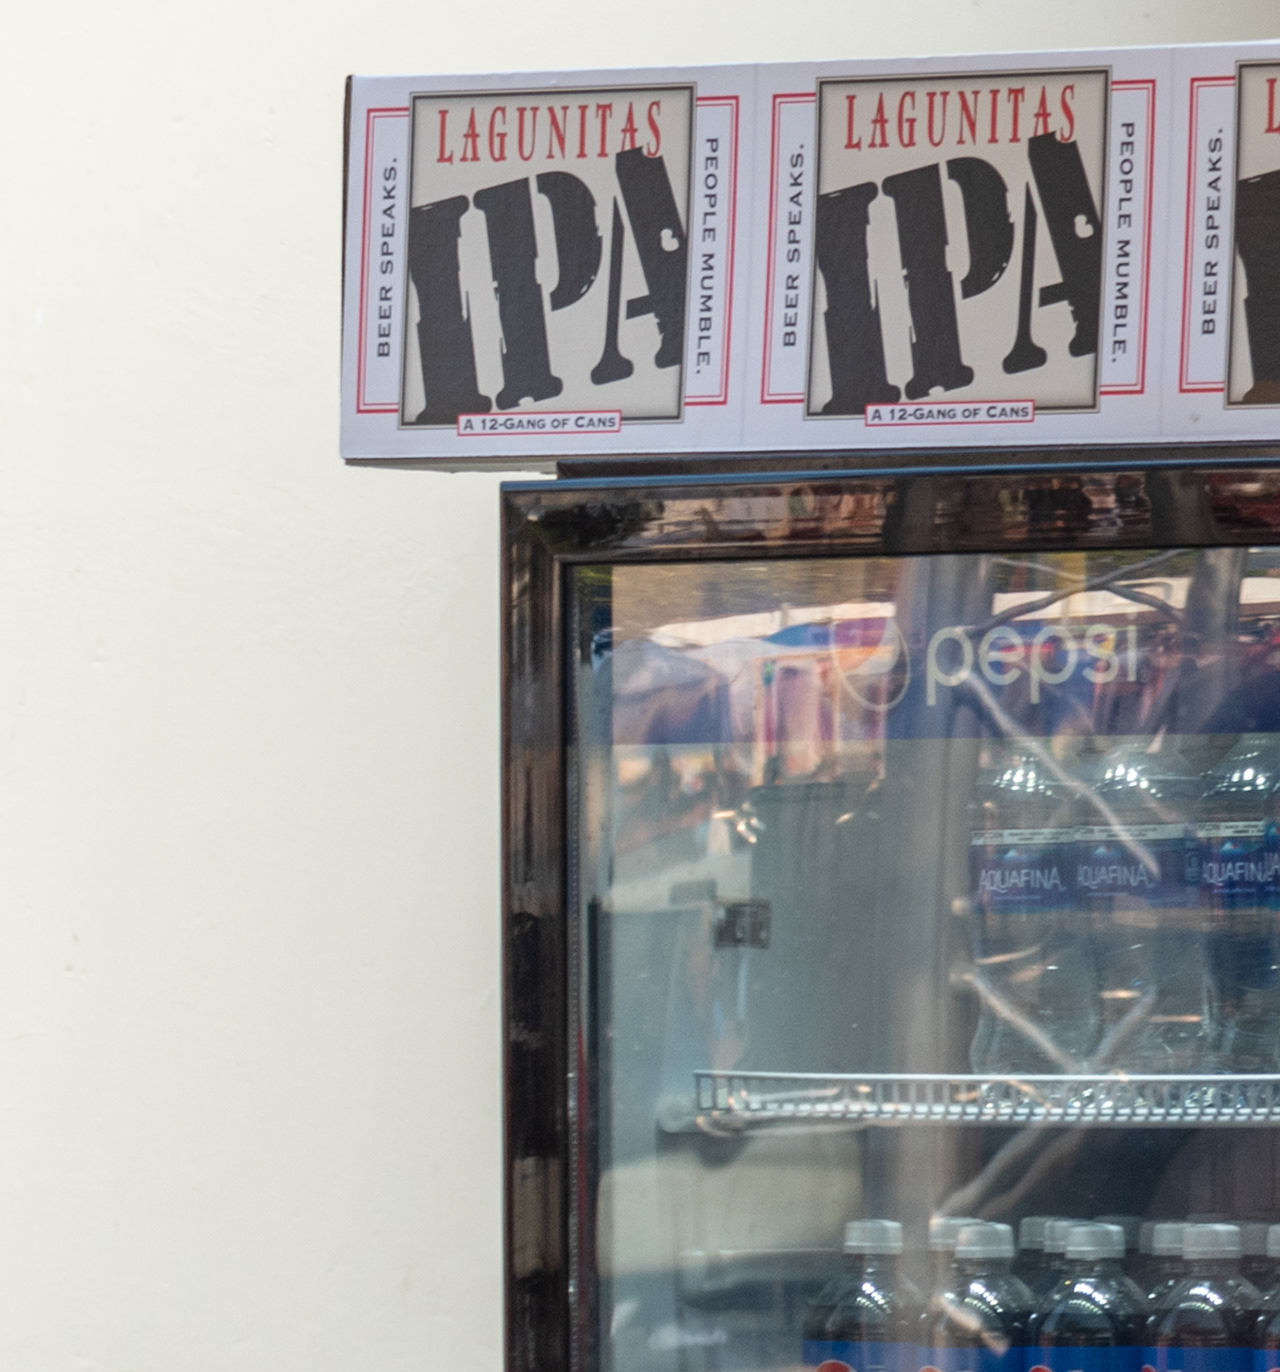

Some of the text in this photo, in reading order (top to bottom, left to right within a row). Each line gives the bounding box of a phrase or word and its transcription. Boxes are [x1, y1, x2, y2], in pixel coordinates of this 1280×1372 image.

[436, 100, 662, 164] LAGUNITAS
[844, 83, 1076, 151] LAGUNITAS
[377, 156, 398, 358] BEER SPEAKS.
[407, 145, 687, 424] IPA
[695, 136, 720, 375] PEOPLE MUMBLE.
[783, 143, 805, 348] BEER SPEAKS.
[816, 131, 1102, 416] IPA
[1111, 121, 1136, 364] PEOPLE MUMBLE.
[1202, 128, 1224, 336] BEER SPEAKS.
[463, 418, 475, 432] A
[871, 408, 883, 422] A
[926, 611, 1138, 707] pepsi
[979, 866, 1067, 893] AQUAFINA
